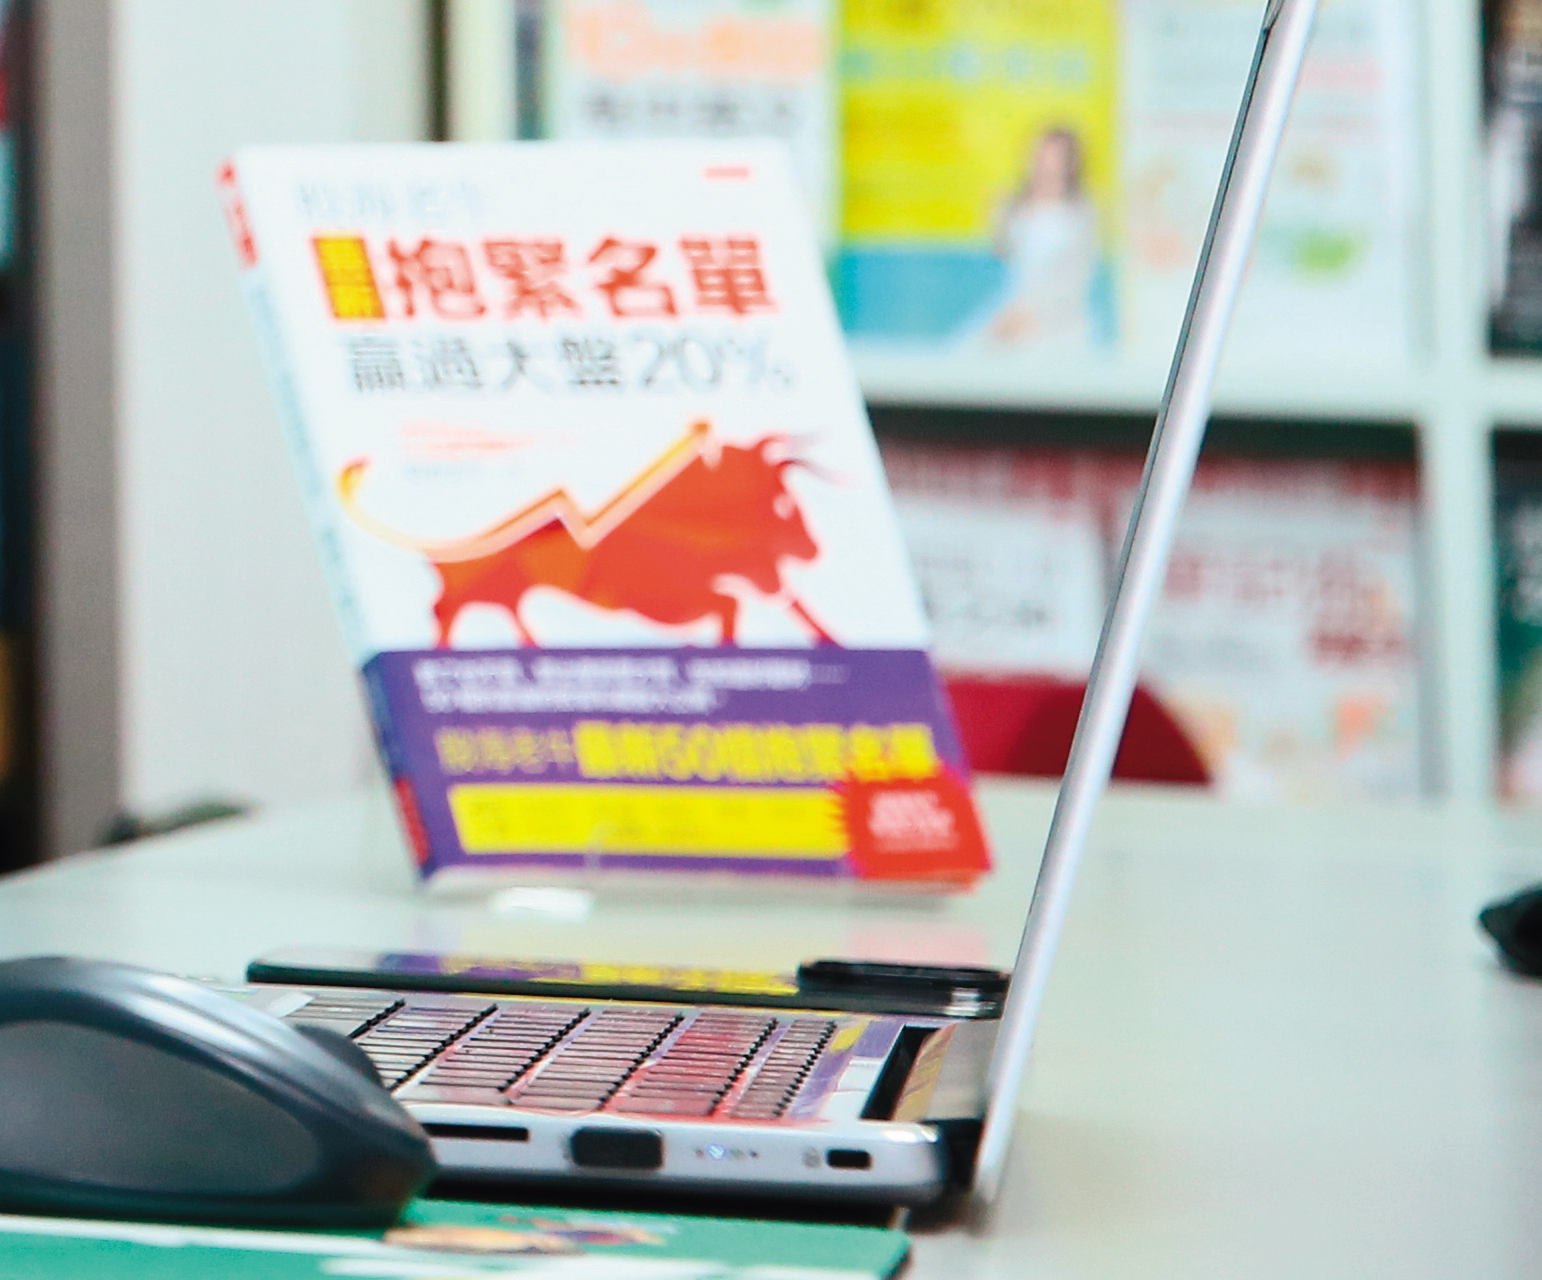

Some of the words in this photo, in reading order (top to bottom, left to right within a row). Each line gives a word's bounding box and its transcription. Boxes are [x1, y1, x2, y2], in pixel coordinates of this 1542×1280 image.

[387, 236, 776, 320] 抱緊名單
[347, 331, 798, 393] 贏過大盤20%
